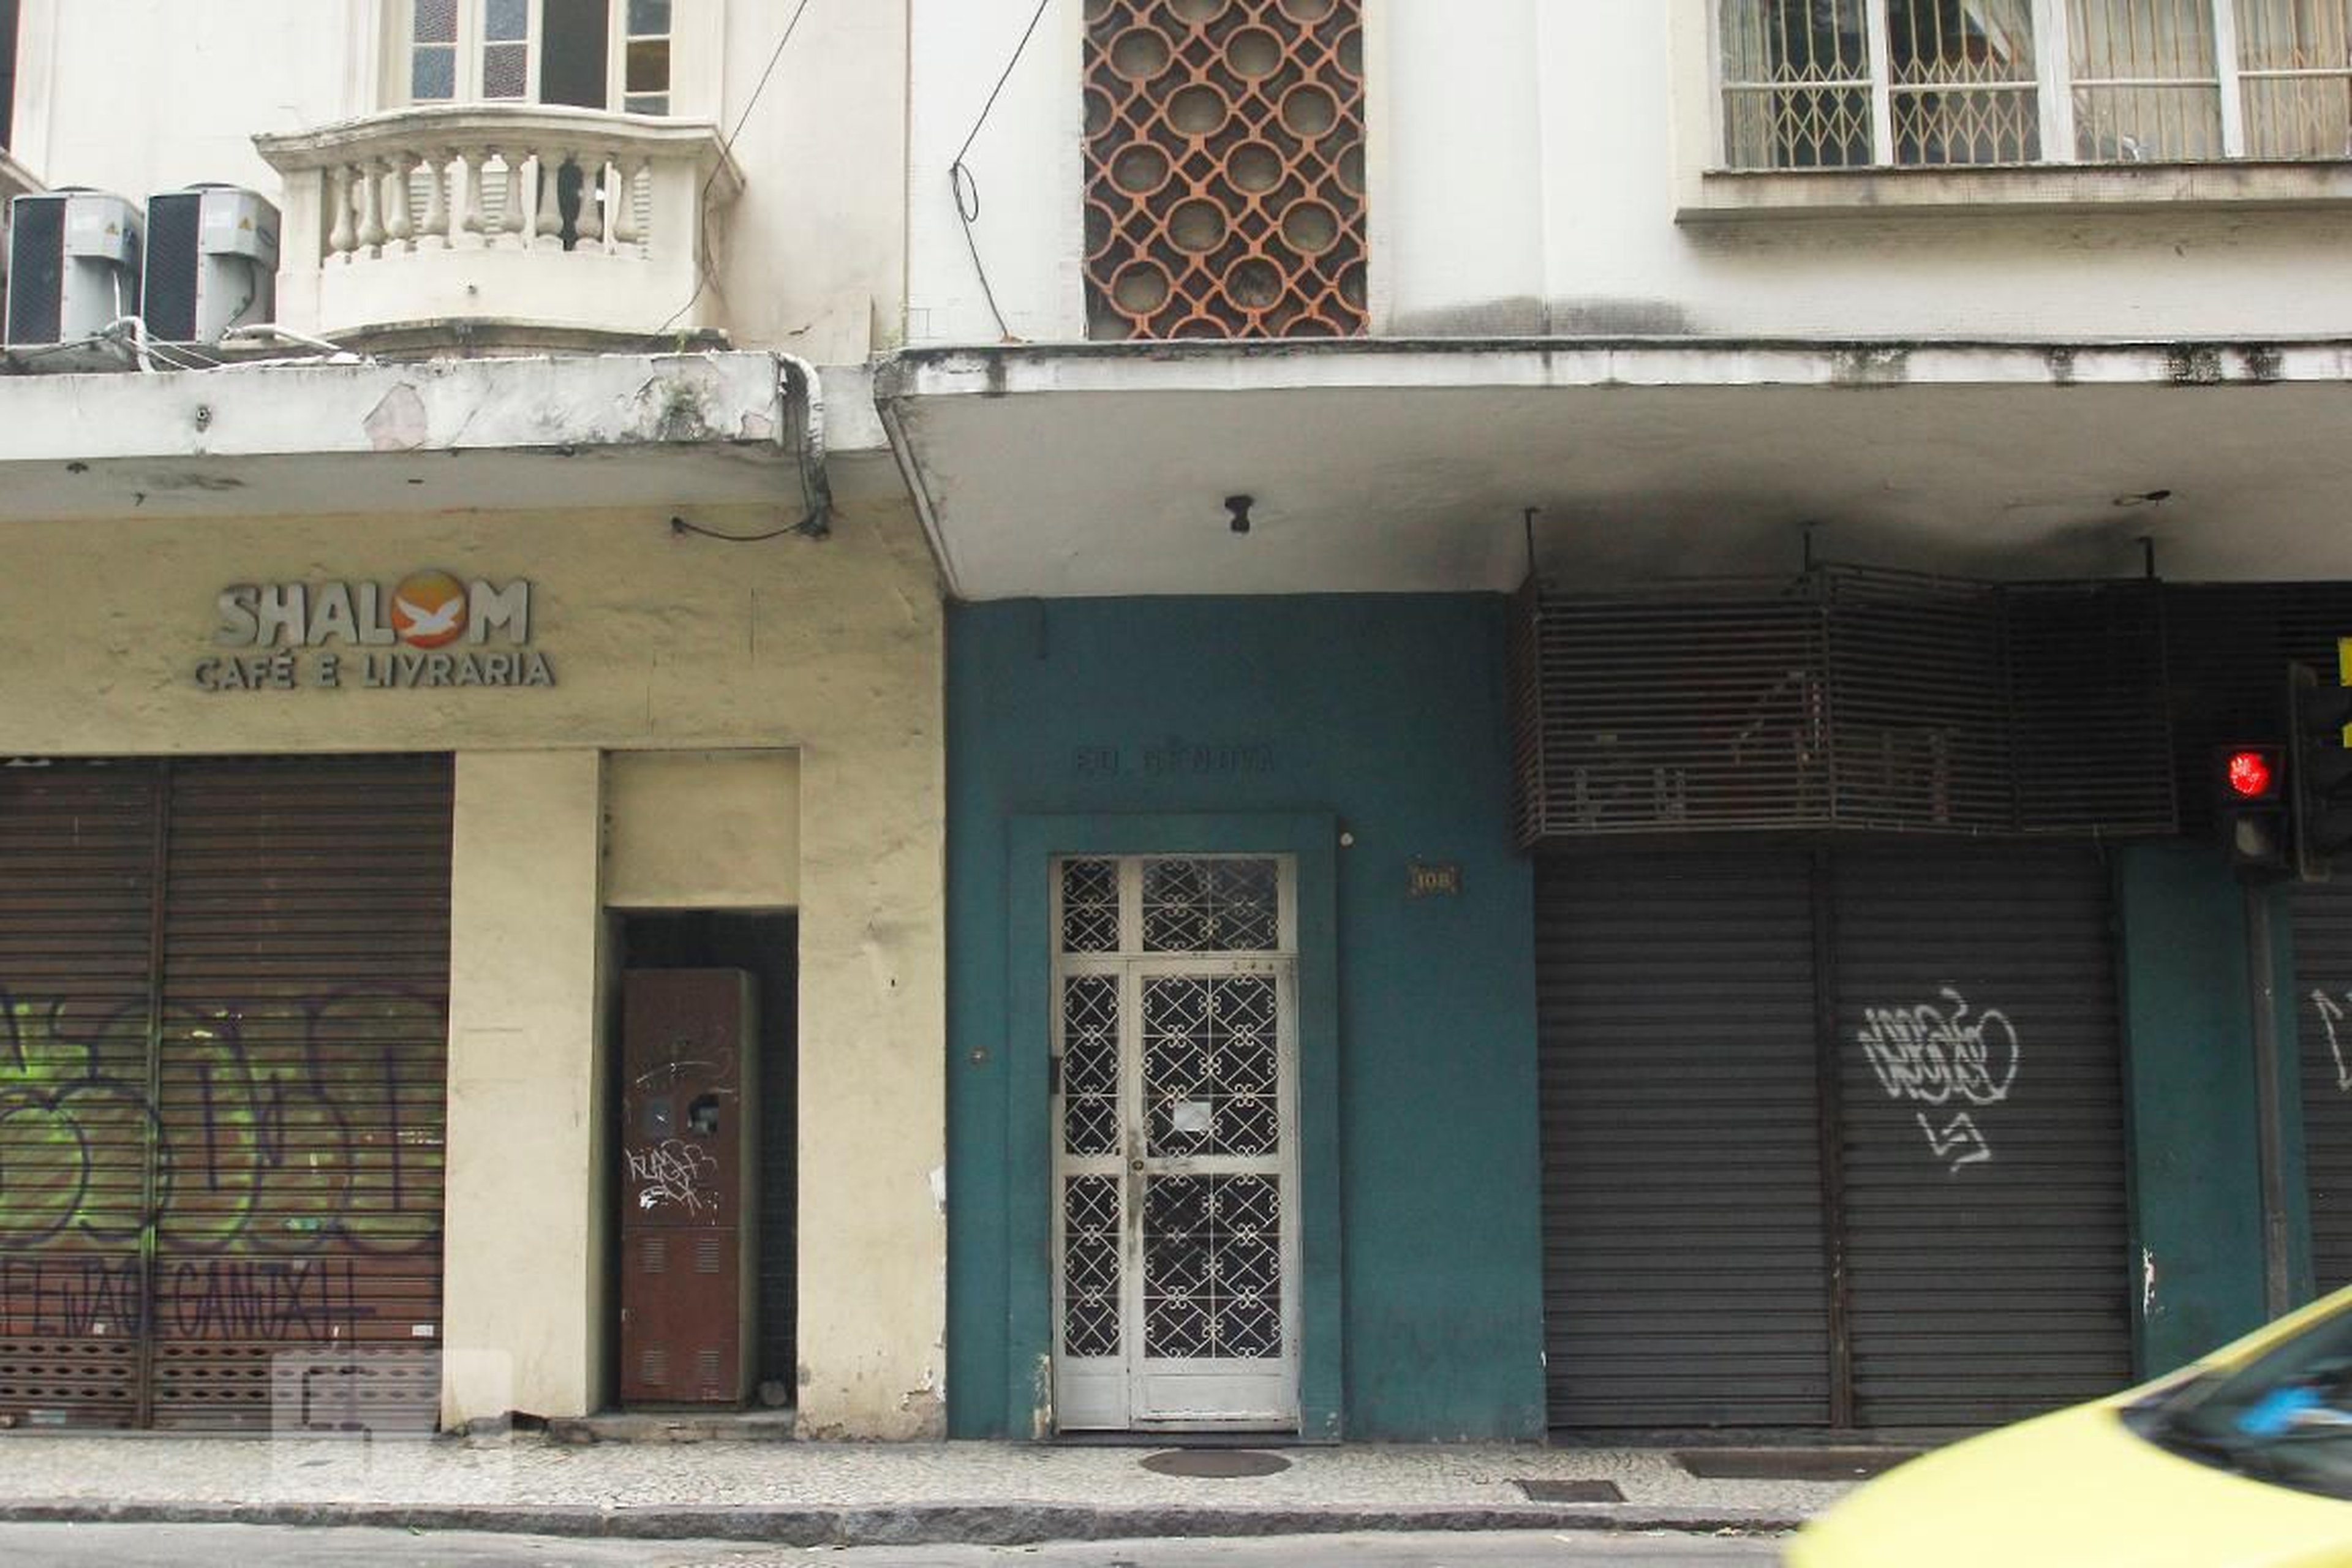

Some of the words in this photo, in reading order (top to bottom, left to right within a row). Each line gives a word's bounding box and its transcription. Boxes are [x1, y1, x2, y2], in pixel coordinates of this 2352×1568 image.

[217, 569, 532, 649] SHALOM
[194, 648, 295, 692] CAFÉ
[315, 654, 341, 688] E
[362, 651, 556, 687] LIVRARIA
